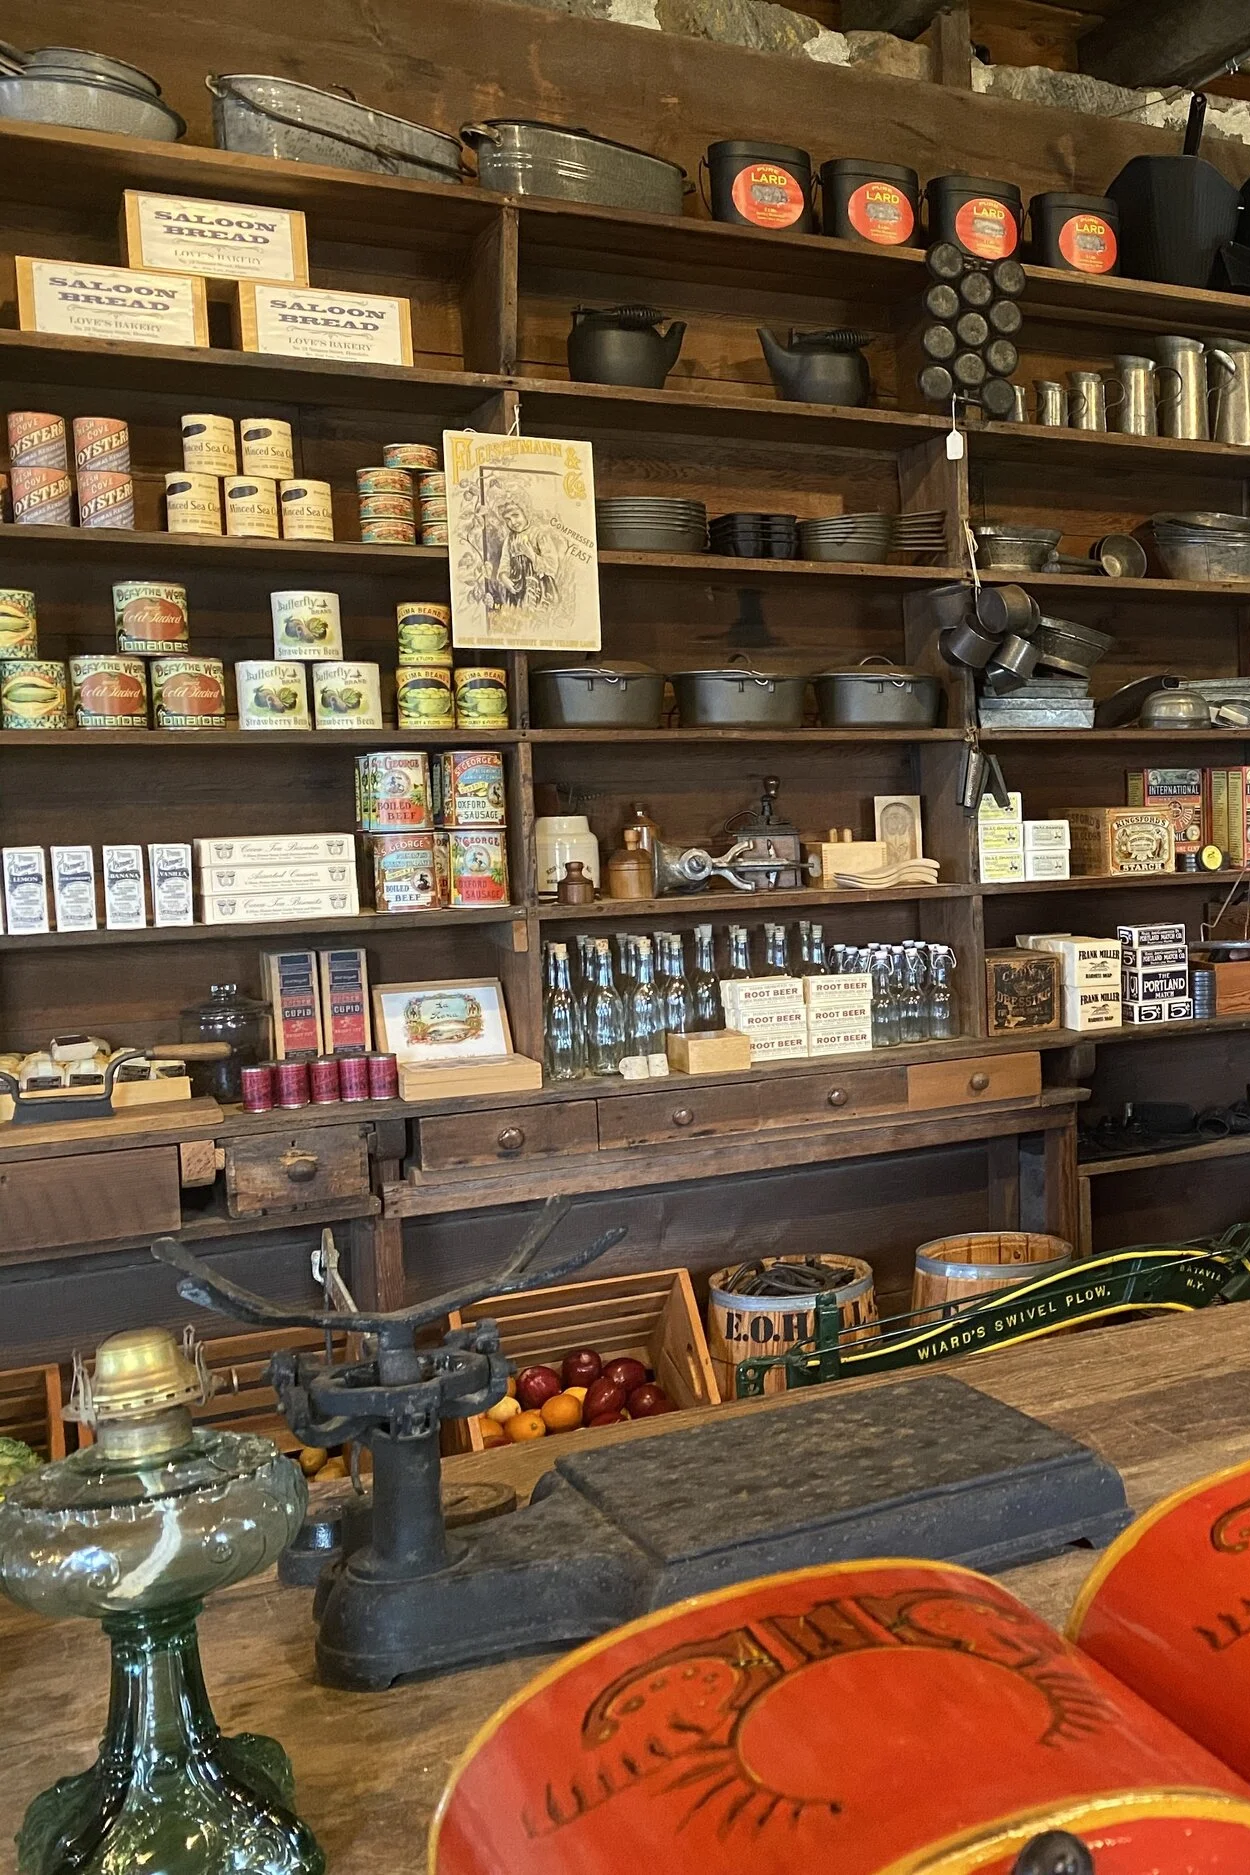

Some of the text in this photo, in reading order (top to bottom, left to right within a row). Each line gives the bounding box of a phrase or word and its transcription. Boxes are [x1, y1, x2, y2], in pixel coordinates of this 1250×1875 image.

[751, 172, 787, 185] LARD
[866, 191, 899, 203] LARD
[974, 206, 1005, 220] LARD
[155, 210, 277, 232] SALOON
[1076, 222, 1105, 234] LARD
[163, 225, 269, 244] BREAD
[49, 277, 177, 299] SALOON
[58, 292, 169, 311] BREAD
[270, 300, 386, 319] SALOON
[69, 316, 110, 326] LOVE'S
[115, 320, 162, 332] BAKERY
[279, 313, 379, 331] BREAD
[288, 337, 373, 351] LOVE'S BAKERY
[10, 421, 64, 460] OYSTERS
[78, 428, 128, 465] OYSTERS
[206, 443, 220, 453] Sea
[271, 447, 284, 458] Sea
[450, 437, 562, 485] FLEISCHMANN
[15, 477, 70, 515] OYSTERS
[82, 480, 133, 518] OYSTERS
[191, 501, 205, 511] Sea
[230, 504, 269, 514] Minced Sea
[307, 507, 320, 517] Sea
[550, 518, 595, 549] COMPRESSED
[567, 540, 592, 564] YEAST
[400, 607, 414, 617] LIMA
[103, 663, 120, 671] THE
[405, 672, 421, 680] LIMA
[465, 672, 481, 680] LIMA
[462, 756, 491, 770] GEORGE
[1149, 785, 1199, 795] INTERNATIONAL
[378, 801, 411, 810] BOILED
[388, 812, 416, 820] BEEF
[465, 811, 498, 819] SAUSAGE
[390, 840, 423, 851] GEORGE
[463, 836, 499, 847] GEORGE
[1123, 863, 1161, 871] STARCH
[386, 885, 409, 893] BOILED
[459, 880, 487, 888] OXFORD
[466, 890, 500, 899] SAUSAGE
[1079, 950, 1119, 960] FRANK MILLER
[1144, 978, 1185, 993] PORTLAND
[745, 988, 798, 999] ROOT BEER
[1081, 992, 1120, 1005] FRANK MILLER
[1155, 991, 1174, 999] MATCH
[285, 1009, 311, 1018] CUPID
[334, 1005, 360, 1013] CUPID
[748, 1014, 801, 1025] ROOT BEER
[750, 1039, 802, 1050] ROOT BEER
[817, 1036, 841, 1044] ROOT
[917, 1285, 1111, 1361] WIARD'S SWIVEL PLOW.
